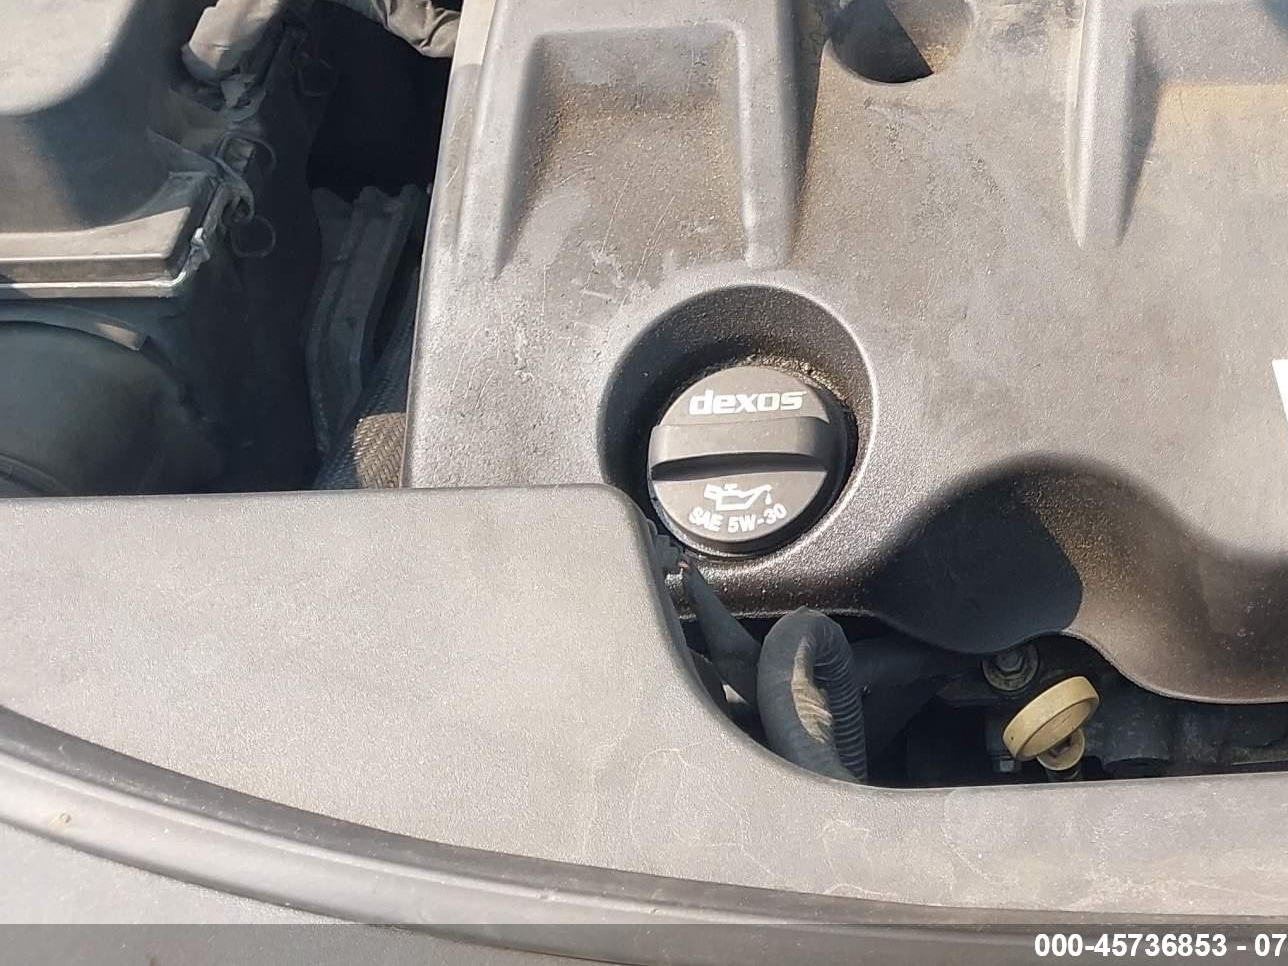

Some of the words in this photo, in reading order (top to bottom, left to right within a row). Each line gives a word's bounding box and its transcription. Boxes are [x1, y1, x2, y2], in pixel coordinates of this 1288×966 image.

[688, 389, 807, 415] dexos
[688, 506, 723, 532] SAE
[727, 502, 788, 533] 5W-30
